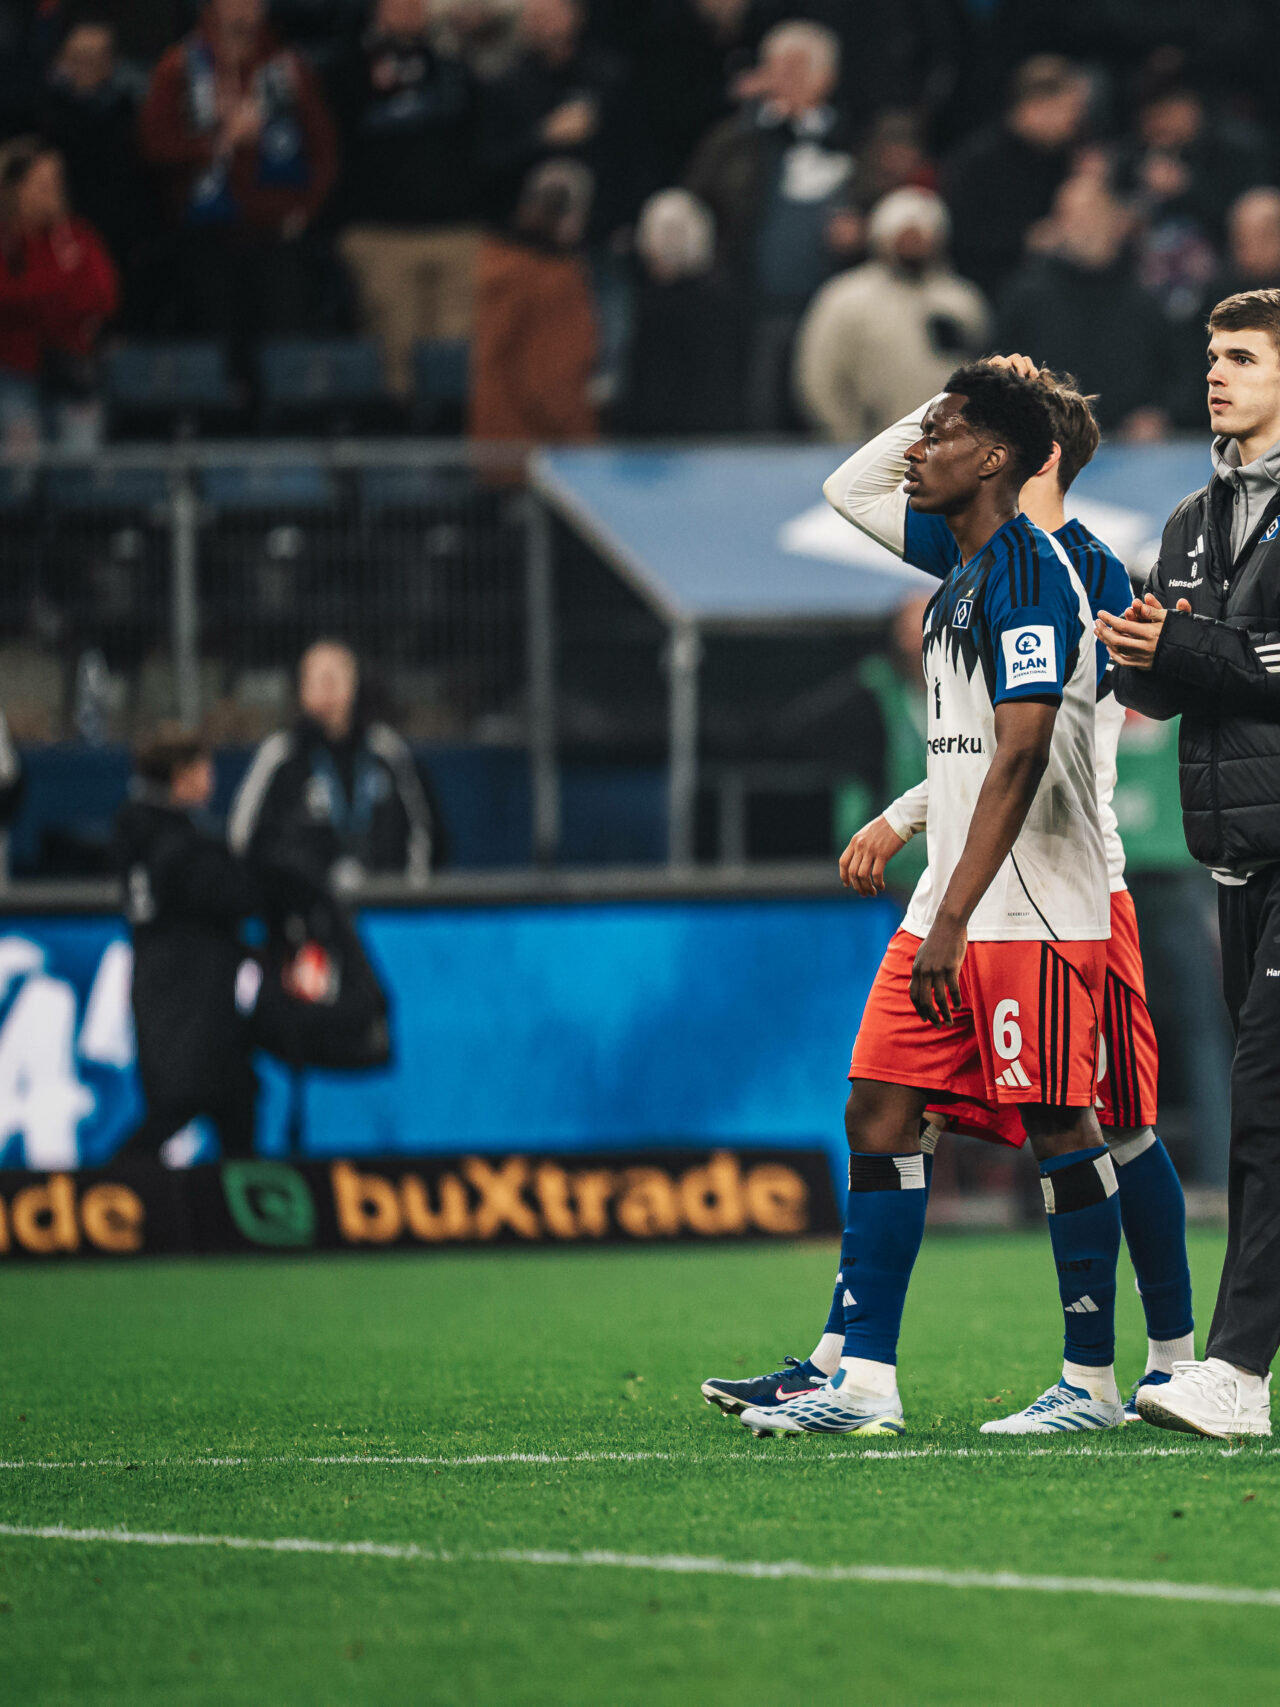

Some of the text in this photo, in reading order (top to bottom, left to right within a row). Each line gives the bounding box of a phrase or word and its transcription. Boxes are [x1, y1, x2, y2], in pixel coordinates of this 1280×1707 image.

[1013, 657, 1047, 673] PLAN
[992, 998, 1022, 1060] 6
[331, 1150, 808, 1243] buXtrade
